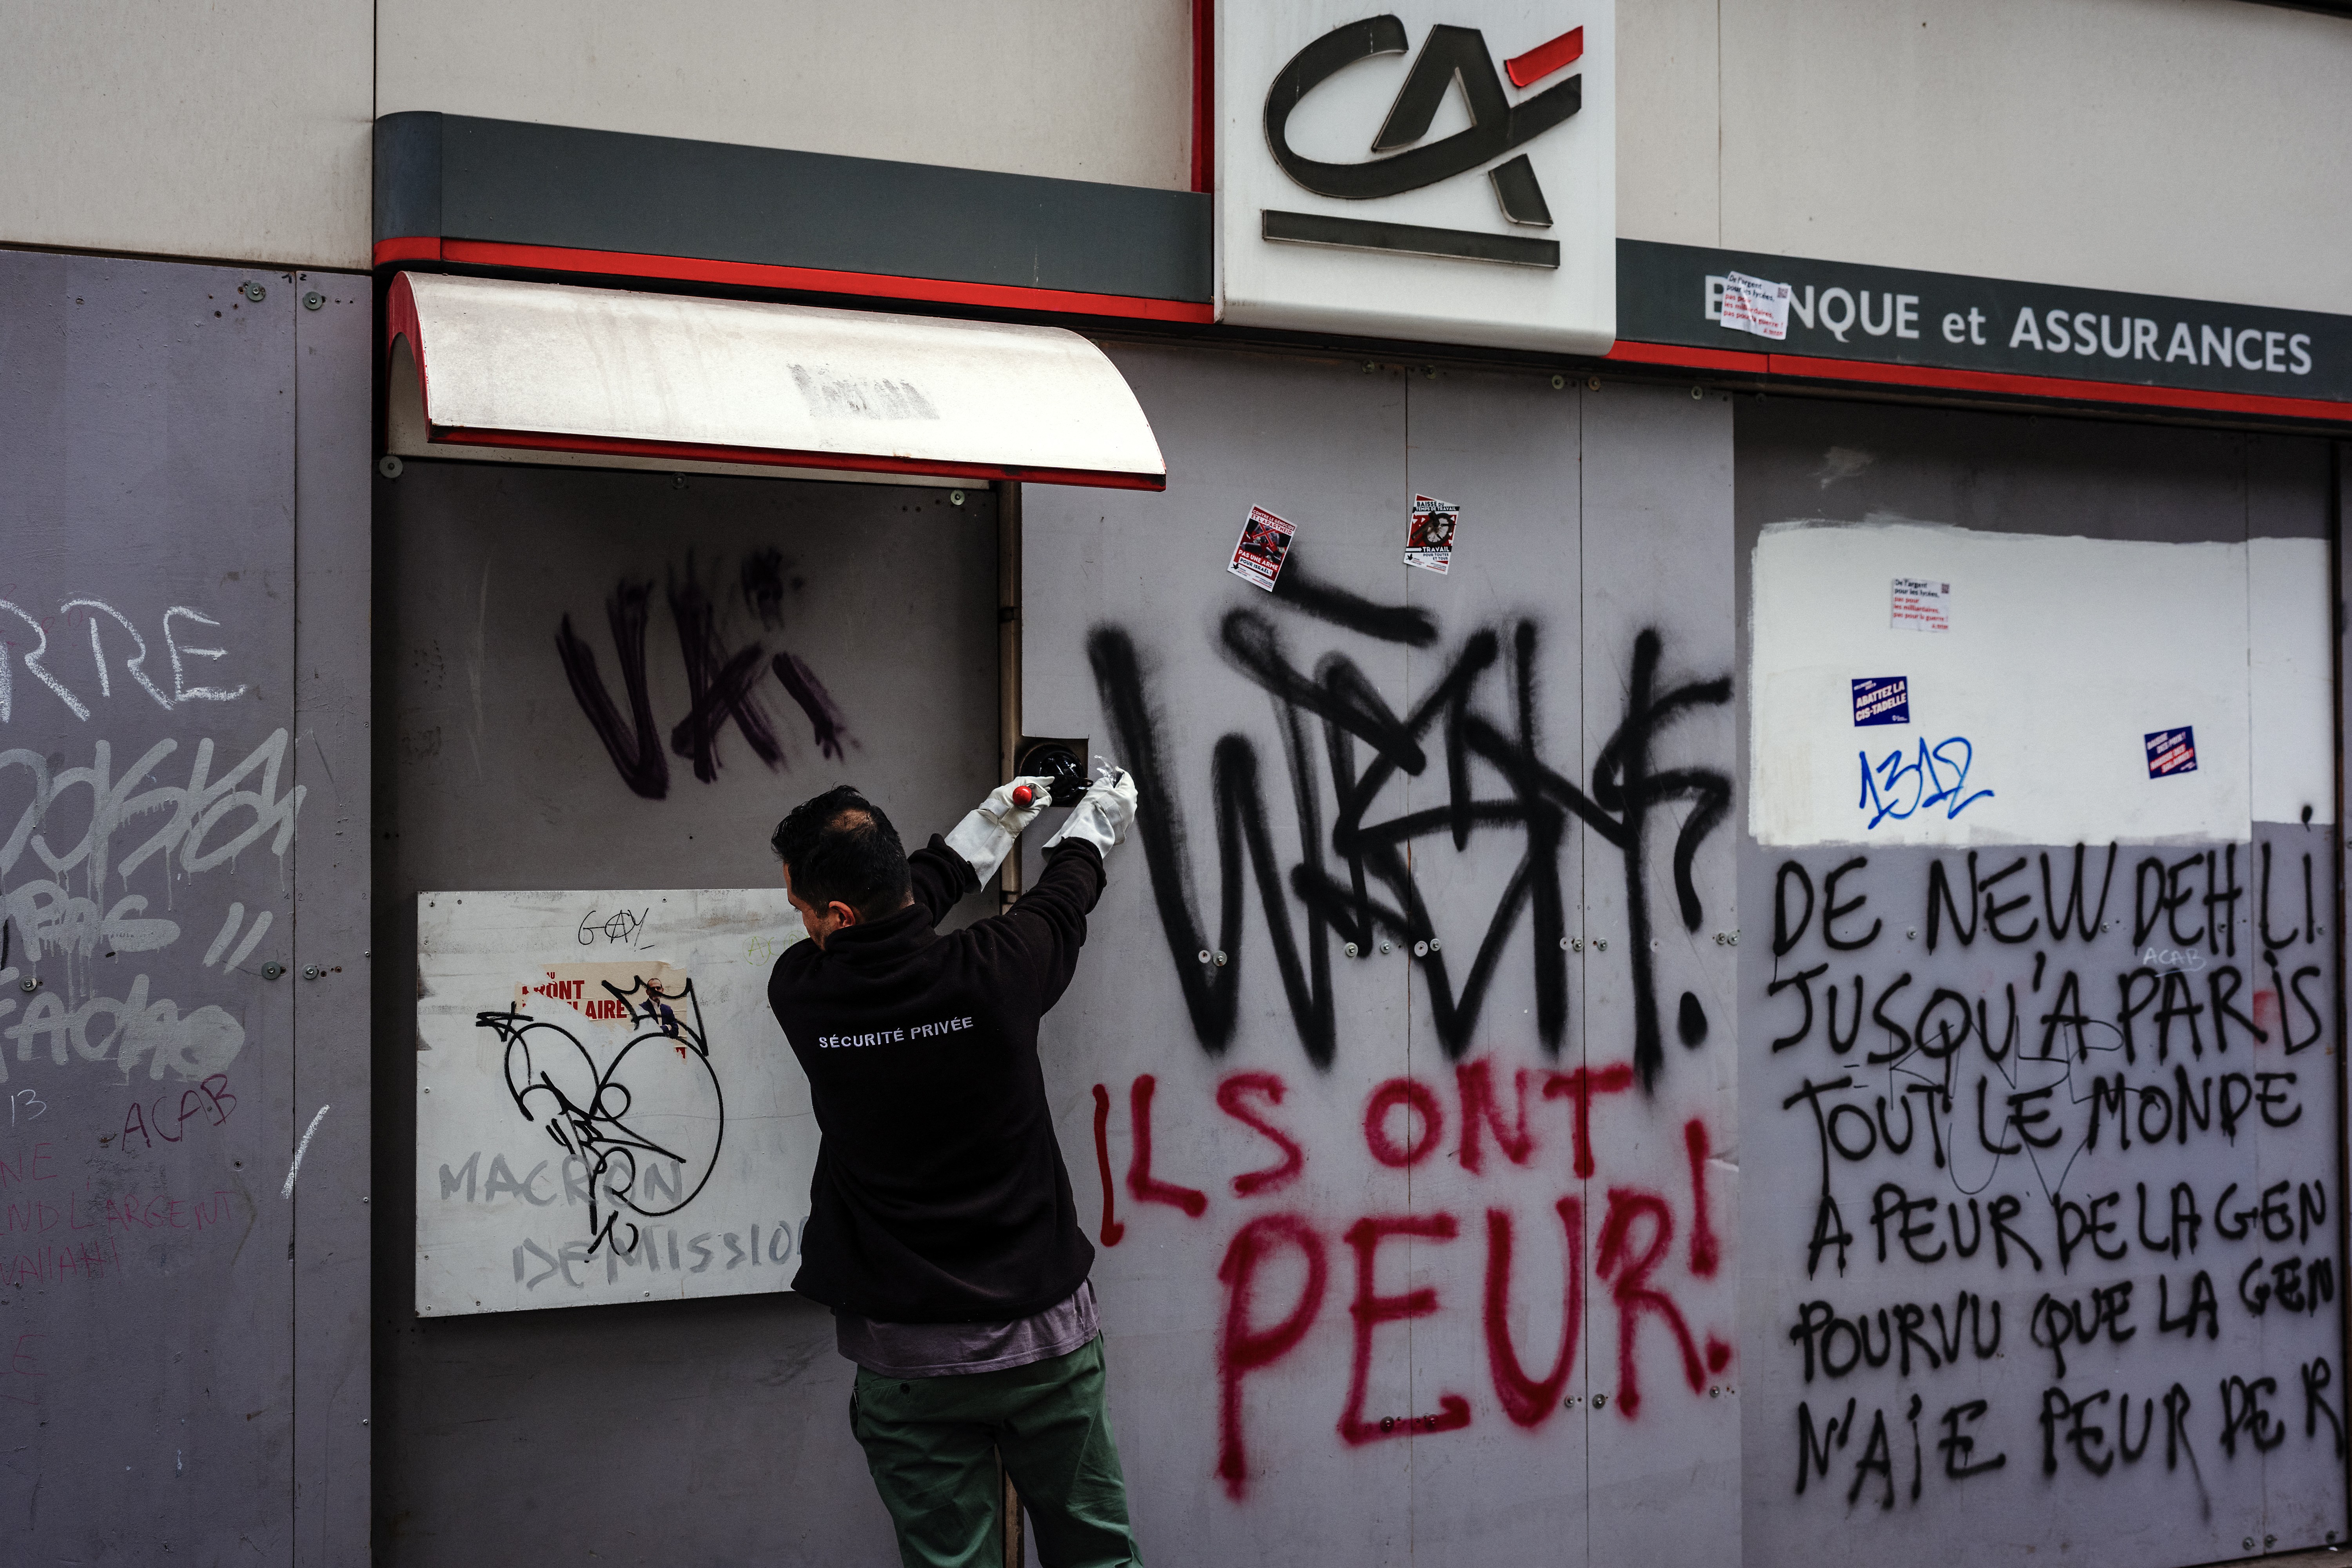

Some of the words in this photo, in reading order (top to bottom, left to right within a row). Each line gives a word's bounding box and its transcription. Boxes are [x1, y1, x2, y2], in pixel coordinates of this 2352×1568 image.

[1727, 285, 1741, 293] pour
[1706, 275, 1919, 342] BNQUE
[1943, 307, 1986, 345] et
[2009, 307, 2312, 375] ASSURANCES
[1253, 510, 1269, 519] CONTRE
[1238, 550, 1249, 558] PAS
[1250, 555, 1261, 563] UNE
[1262, 560, 1278, 571] ARME
[1240, 558, 1253, 567] POUR
[1253, 564, 1269, 573] ISRAËL
[1855, 692, 1907, 722] CIS-TADELLE
[1856, 684, 1893, 709] ABATTEZ
[1892, 680, 1906, 694] LA
[1859, 736, 1995, 830] 1312
[1773, 855, 1882, 956] DE
[1926, 842, 2118, 950] NEW
[2143, 947, 2207, 973] ACAB
[819, 1028, 904, 1048] SÉCURITÉ
[911, 1017, 974, 1040] PRIVÉE
[122, 1073, 237, 1151] ACAB
[1783, 1075, 1947, 1196] TOUT
[1977, 1075, 2063, 1155] LE
[2087, 1064, 2303, 1152] MONDE
[439, 1151, 683, 1207] MACRON
[1092, 1072, 1305, 1247] ILS
[1363, 1058, 1635, 1180] ONT
[1807, 1194, 1853, 1279] A
[1870, 1182, 2043, 1271] PEUR
[2053, 1191, 2127, 1273] DE
[2137, 1181, 2202, 1258] LA
[2214, 1179, 2327, 1245] GEN
[1789, 1290, 2002, 1382] POURVU
[2030, 1279, 2137, 1379] QUE
[2158, 1269, 2220, 1340] LA
[2238, 1256, 2336, 1317] GEN
[2039, 1383, 2212, 1523] PEUR
[2220, 1374, 2286, 1457] DE
